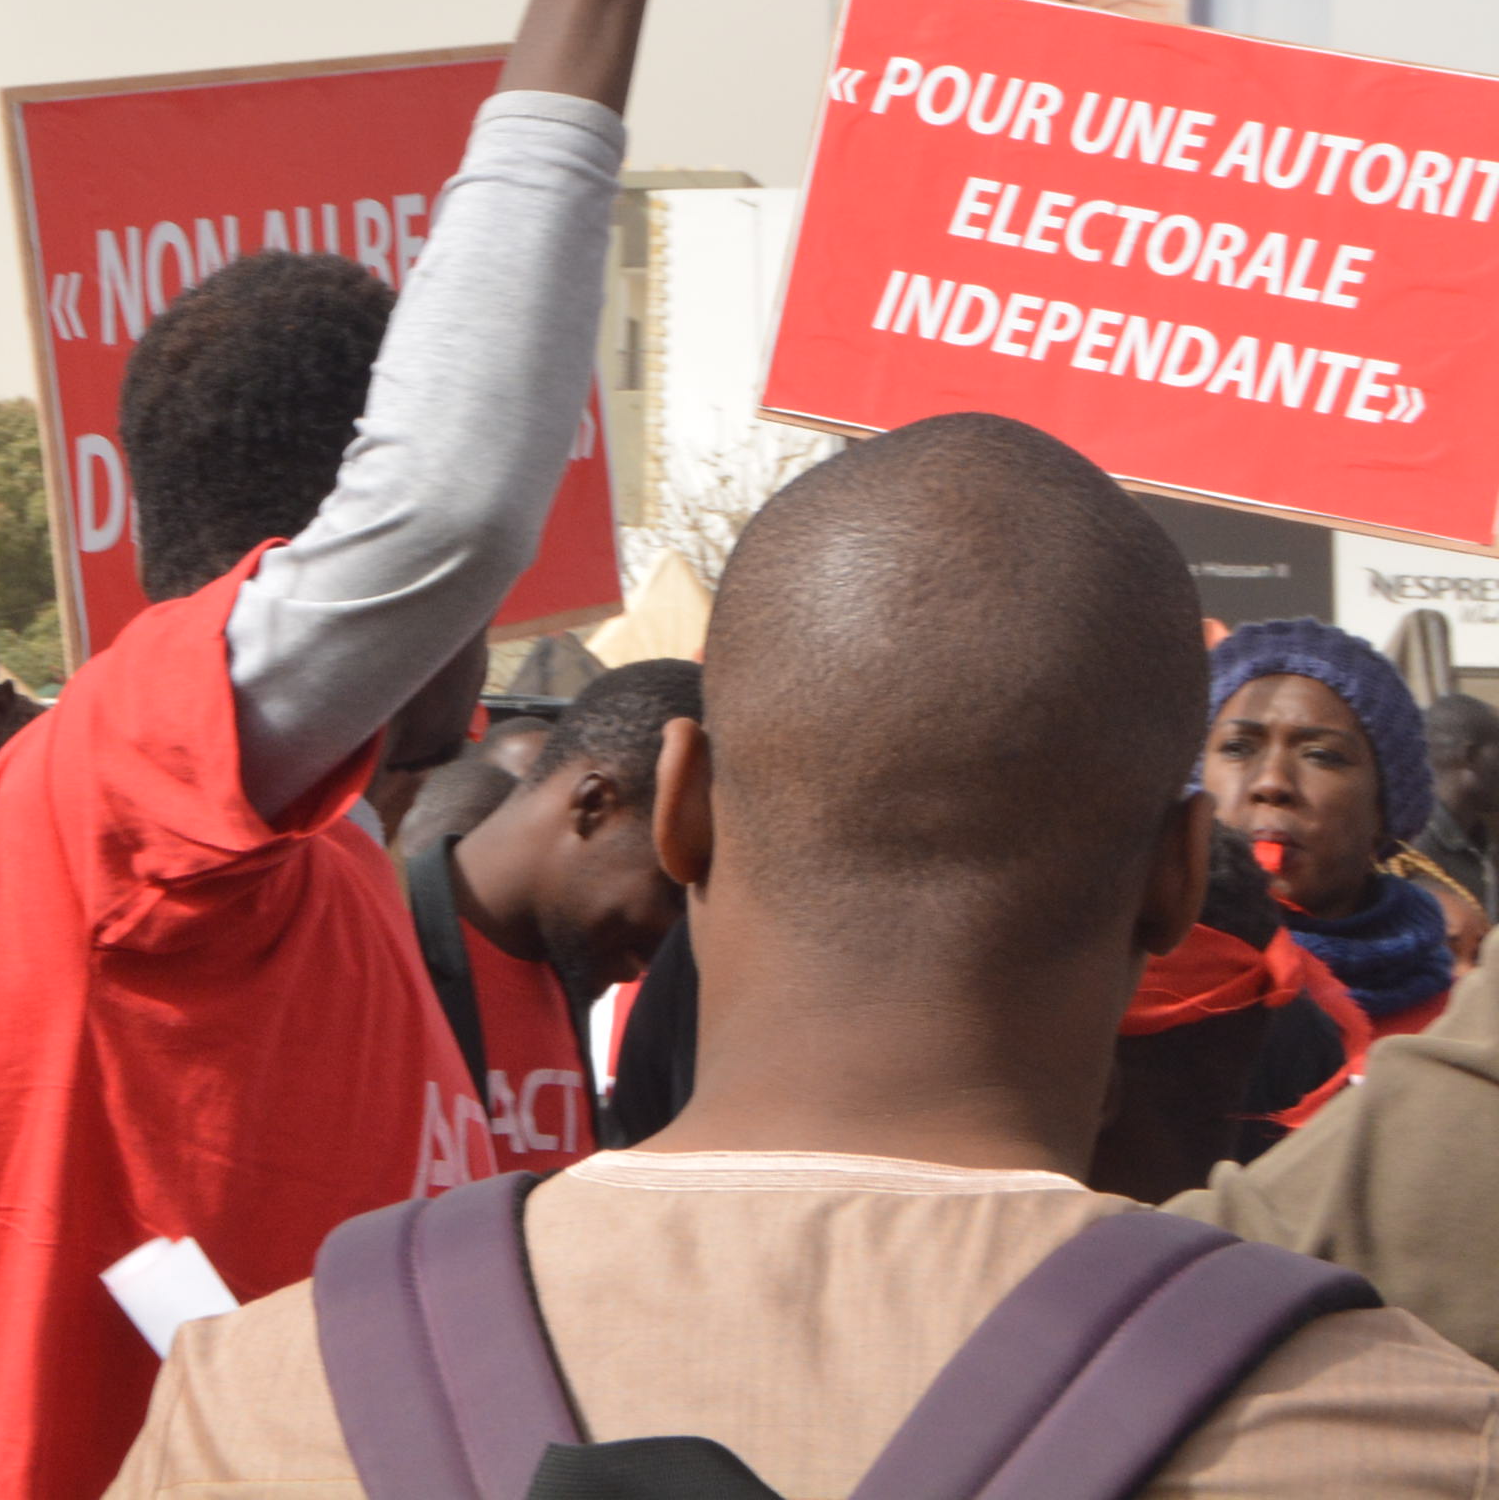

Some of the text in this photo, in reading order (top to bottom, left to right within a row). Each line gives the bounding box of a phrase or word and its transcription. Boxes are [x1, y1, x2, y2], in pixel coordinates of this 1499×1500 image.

[870, 55, 1065, 146] POUR
[1068, 92, 1216, 173] UNE
[947, 176, 1375, 310] ELECTORALE
[871, 270, 1428, 426] INDEPENDANTE»
